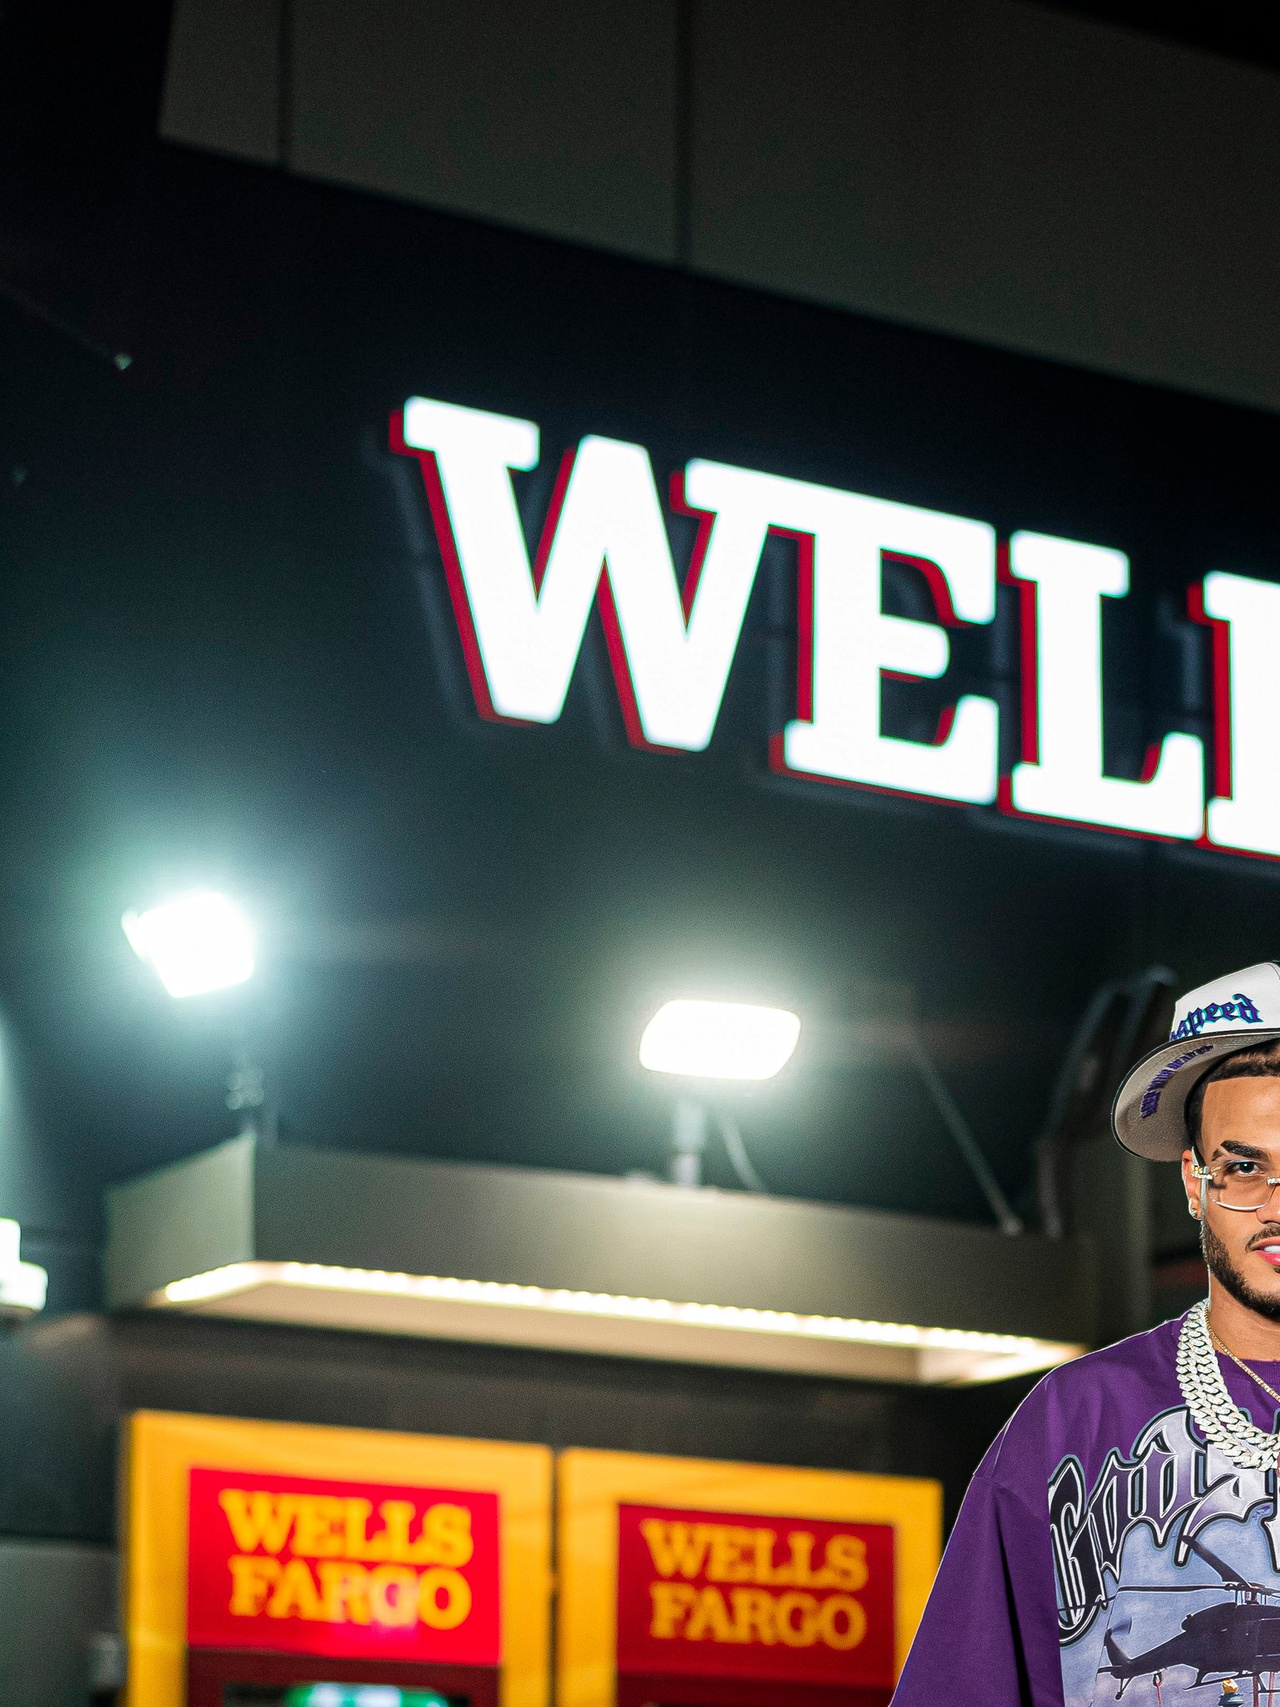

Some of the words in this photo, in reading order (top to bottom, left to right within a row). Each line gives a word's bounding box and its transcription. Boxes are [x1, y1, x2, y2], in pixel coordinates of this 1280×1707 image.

[219, 1489, 474, 1568] WELLS
[640, 1518, 868, 1592] WELLS
[228, 1555, 473, 1630] FARGO
[649, 1580, 867, 1651] FARGO
